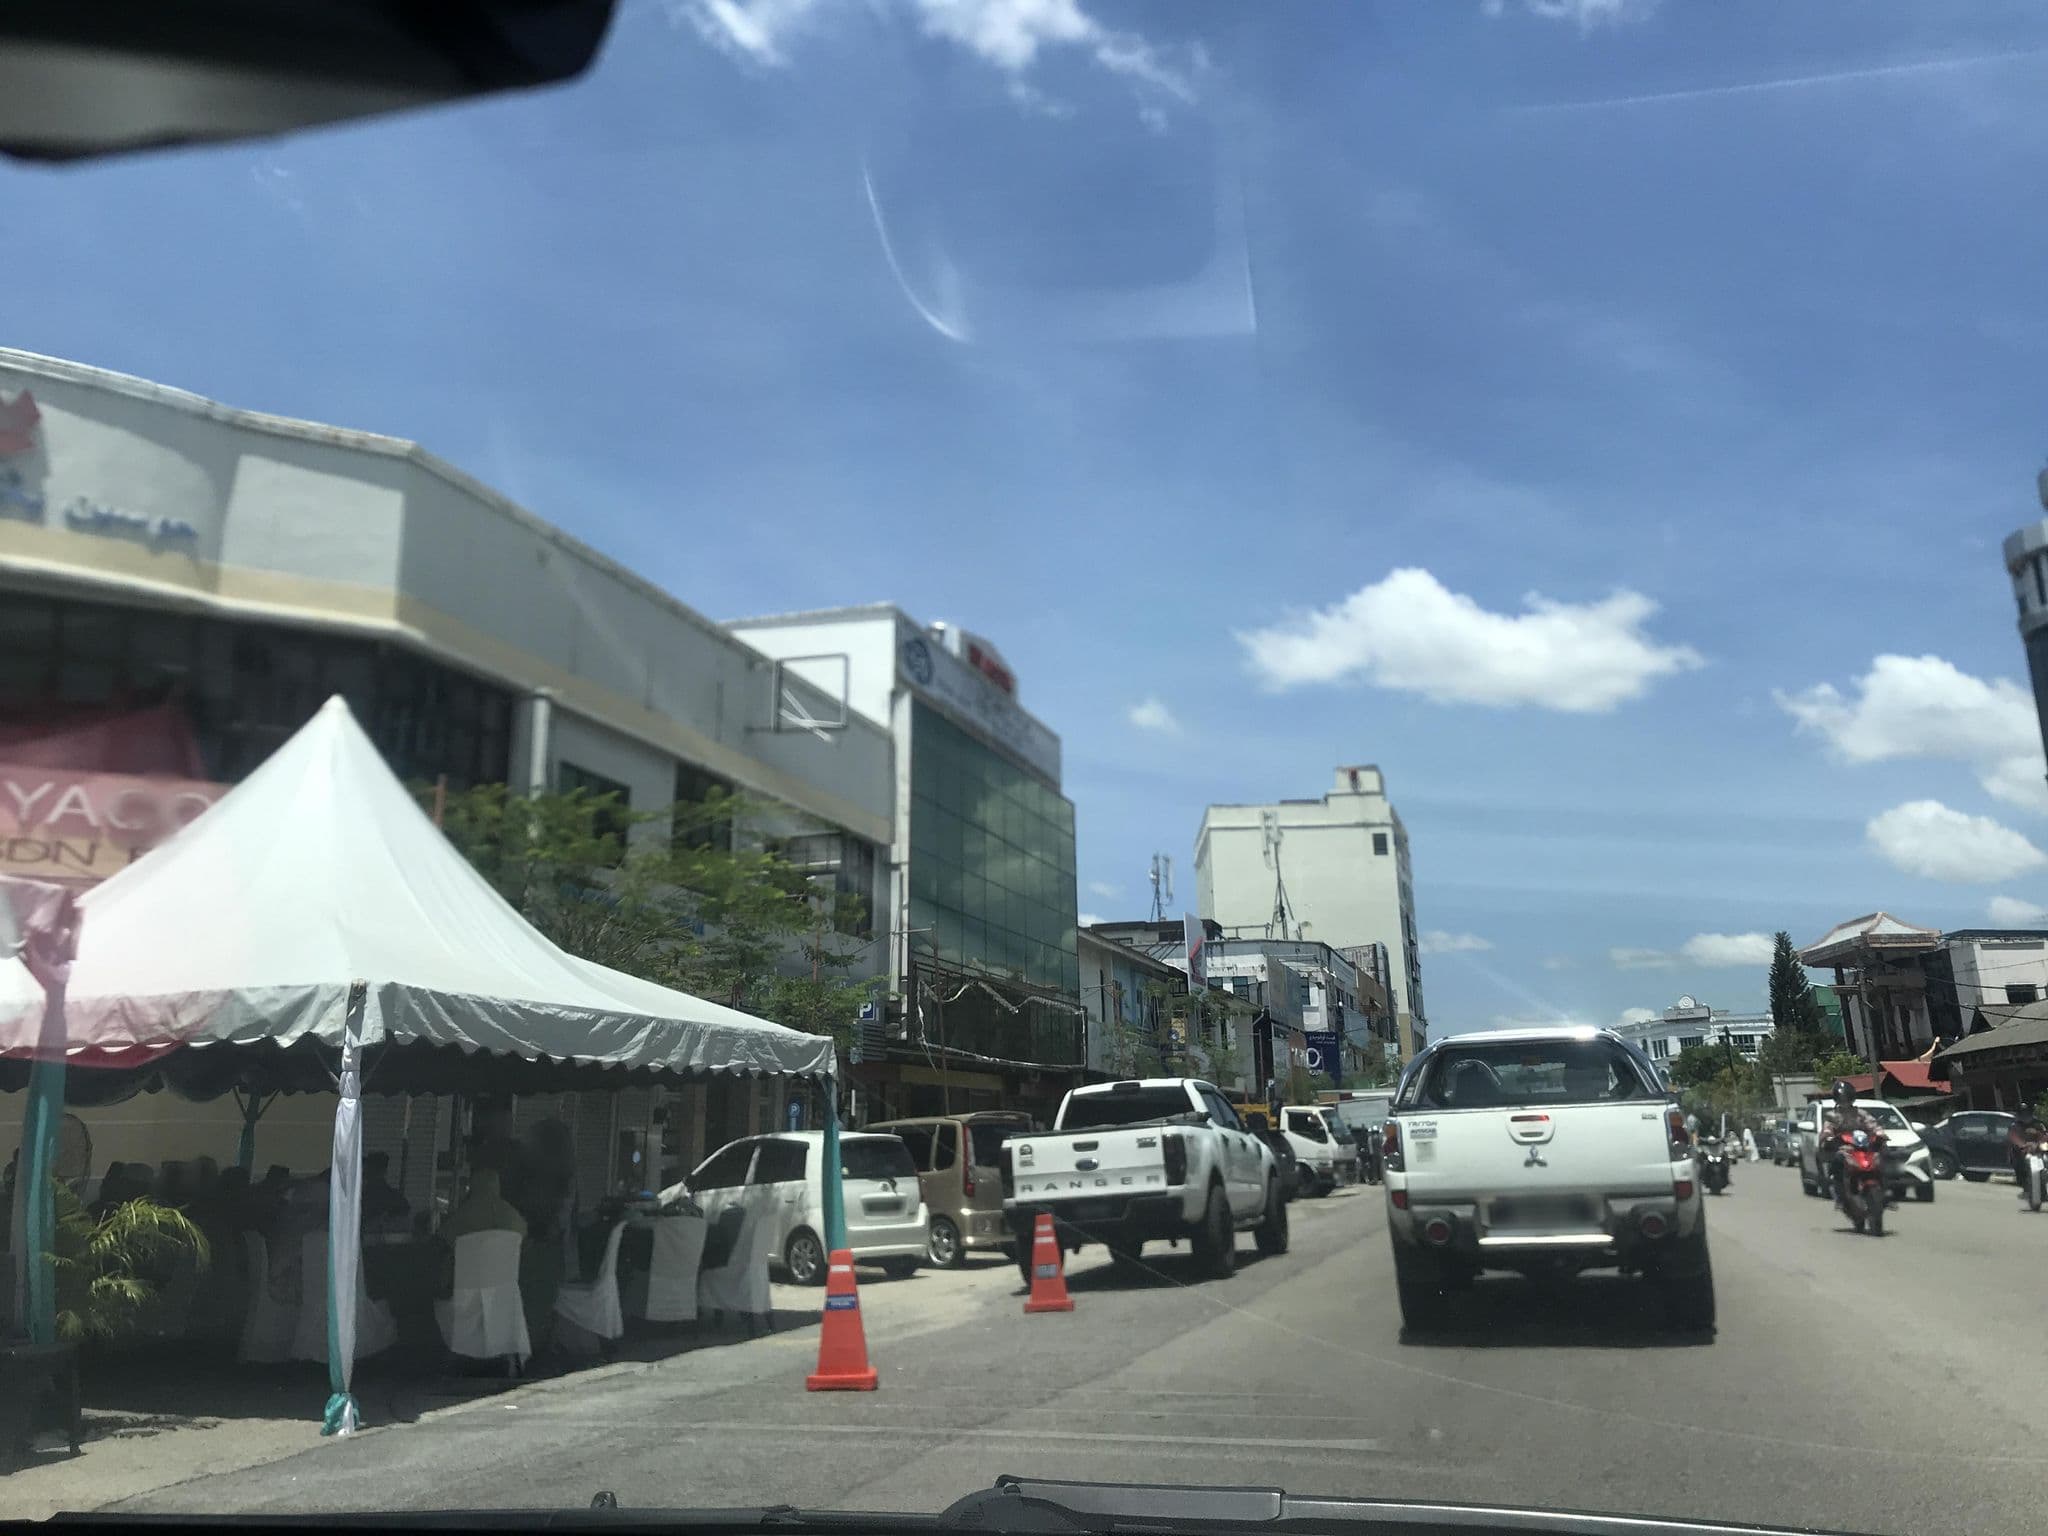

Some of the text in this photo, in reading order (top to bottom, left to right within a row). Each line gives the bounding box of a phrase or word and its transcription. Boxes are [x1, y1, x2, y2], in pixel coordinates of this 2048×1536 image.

[0, 838, 96, 865] DN
[859, 1003, 872, 1018] P
[1021, 1175, 1160, 1192] RANGER
